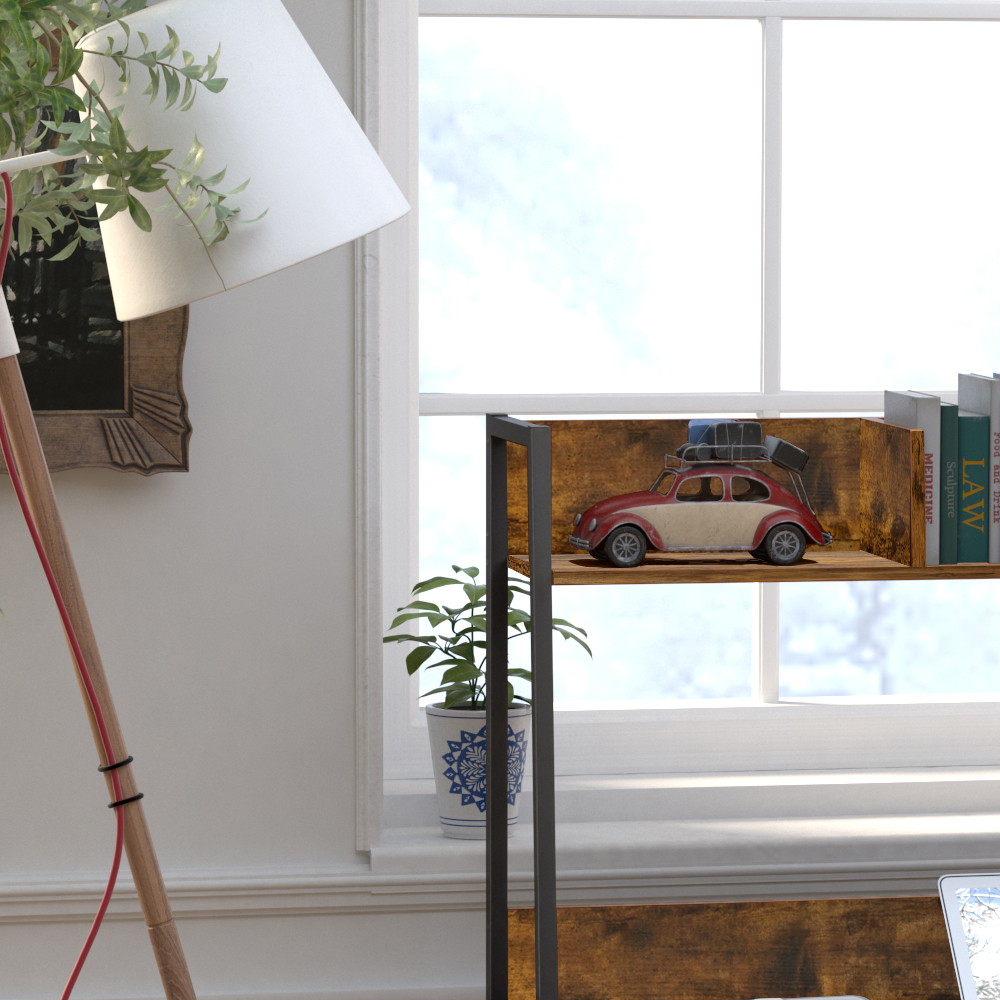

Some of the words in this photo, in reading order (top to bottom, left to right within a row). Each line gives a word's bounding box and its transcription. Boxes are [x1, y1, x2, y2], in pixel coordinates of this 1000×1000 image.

[924, 453, 934, 525] MEDICINE
[944, 461, 957, 519] Sculpture
[962, 458, 985, 532] LAW
